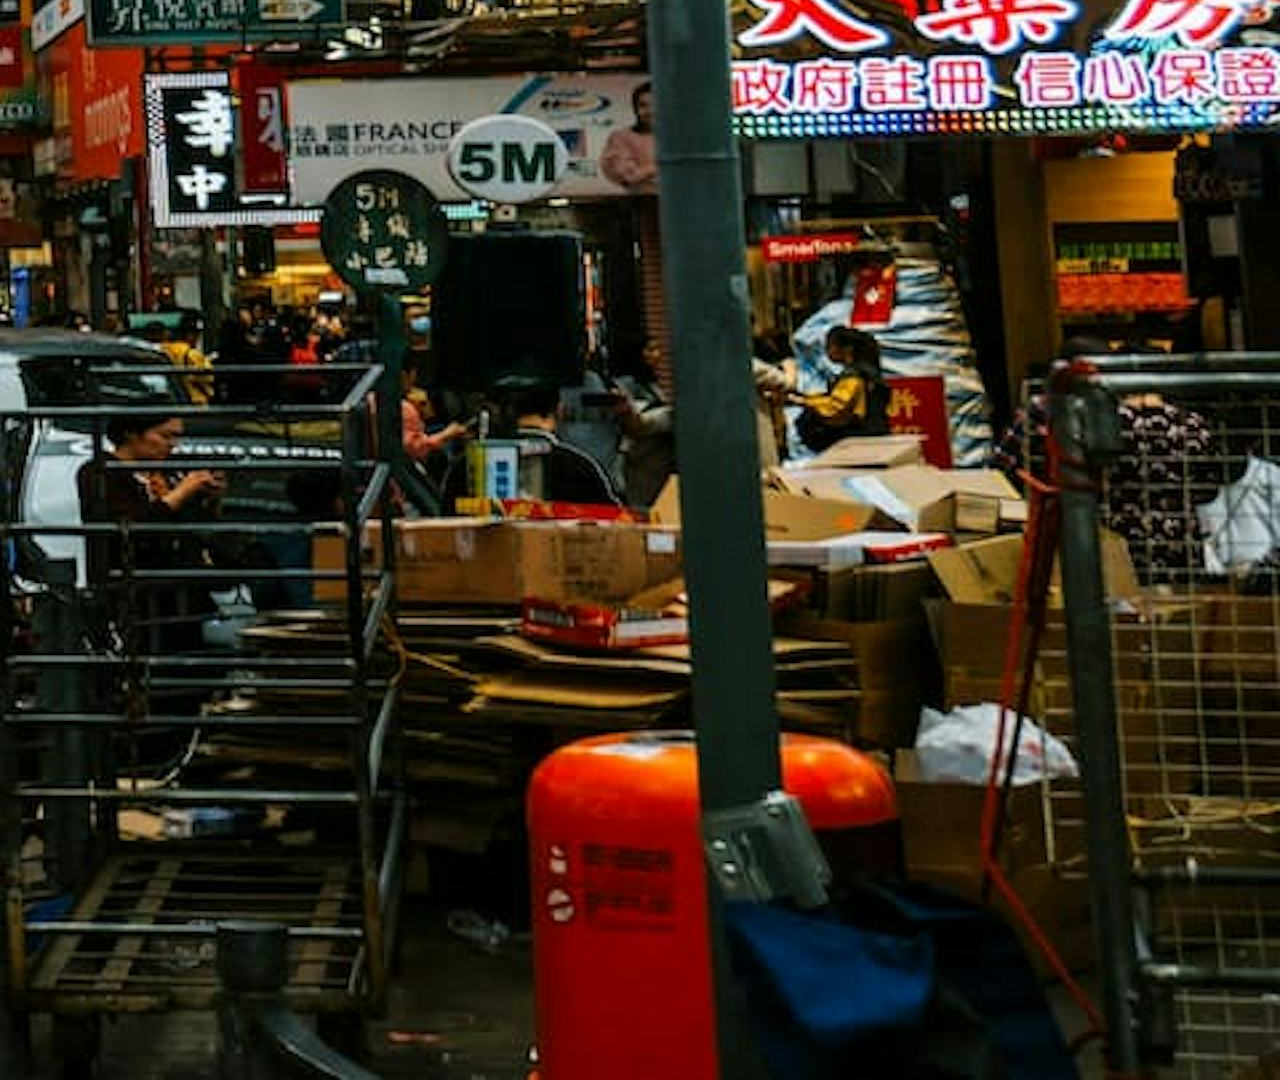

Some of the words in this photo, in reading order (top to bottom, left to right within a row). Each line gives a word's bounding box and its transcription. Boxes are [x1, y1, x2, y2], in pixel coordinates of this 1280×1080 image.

[732, 56, 991, 113] 政府註冊
[1018, 47, 1280, 109] 信心保證
[459, 141, 555, 184] 5M
